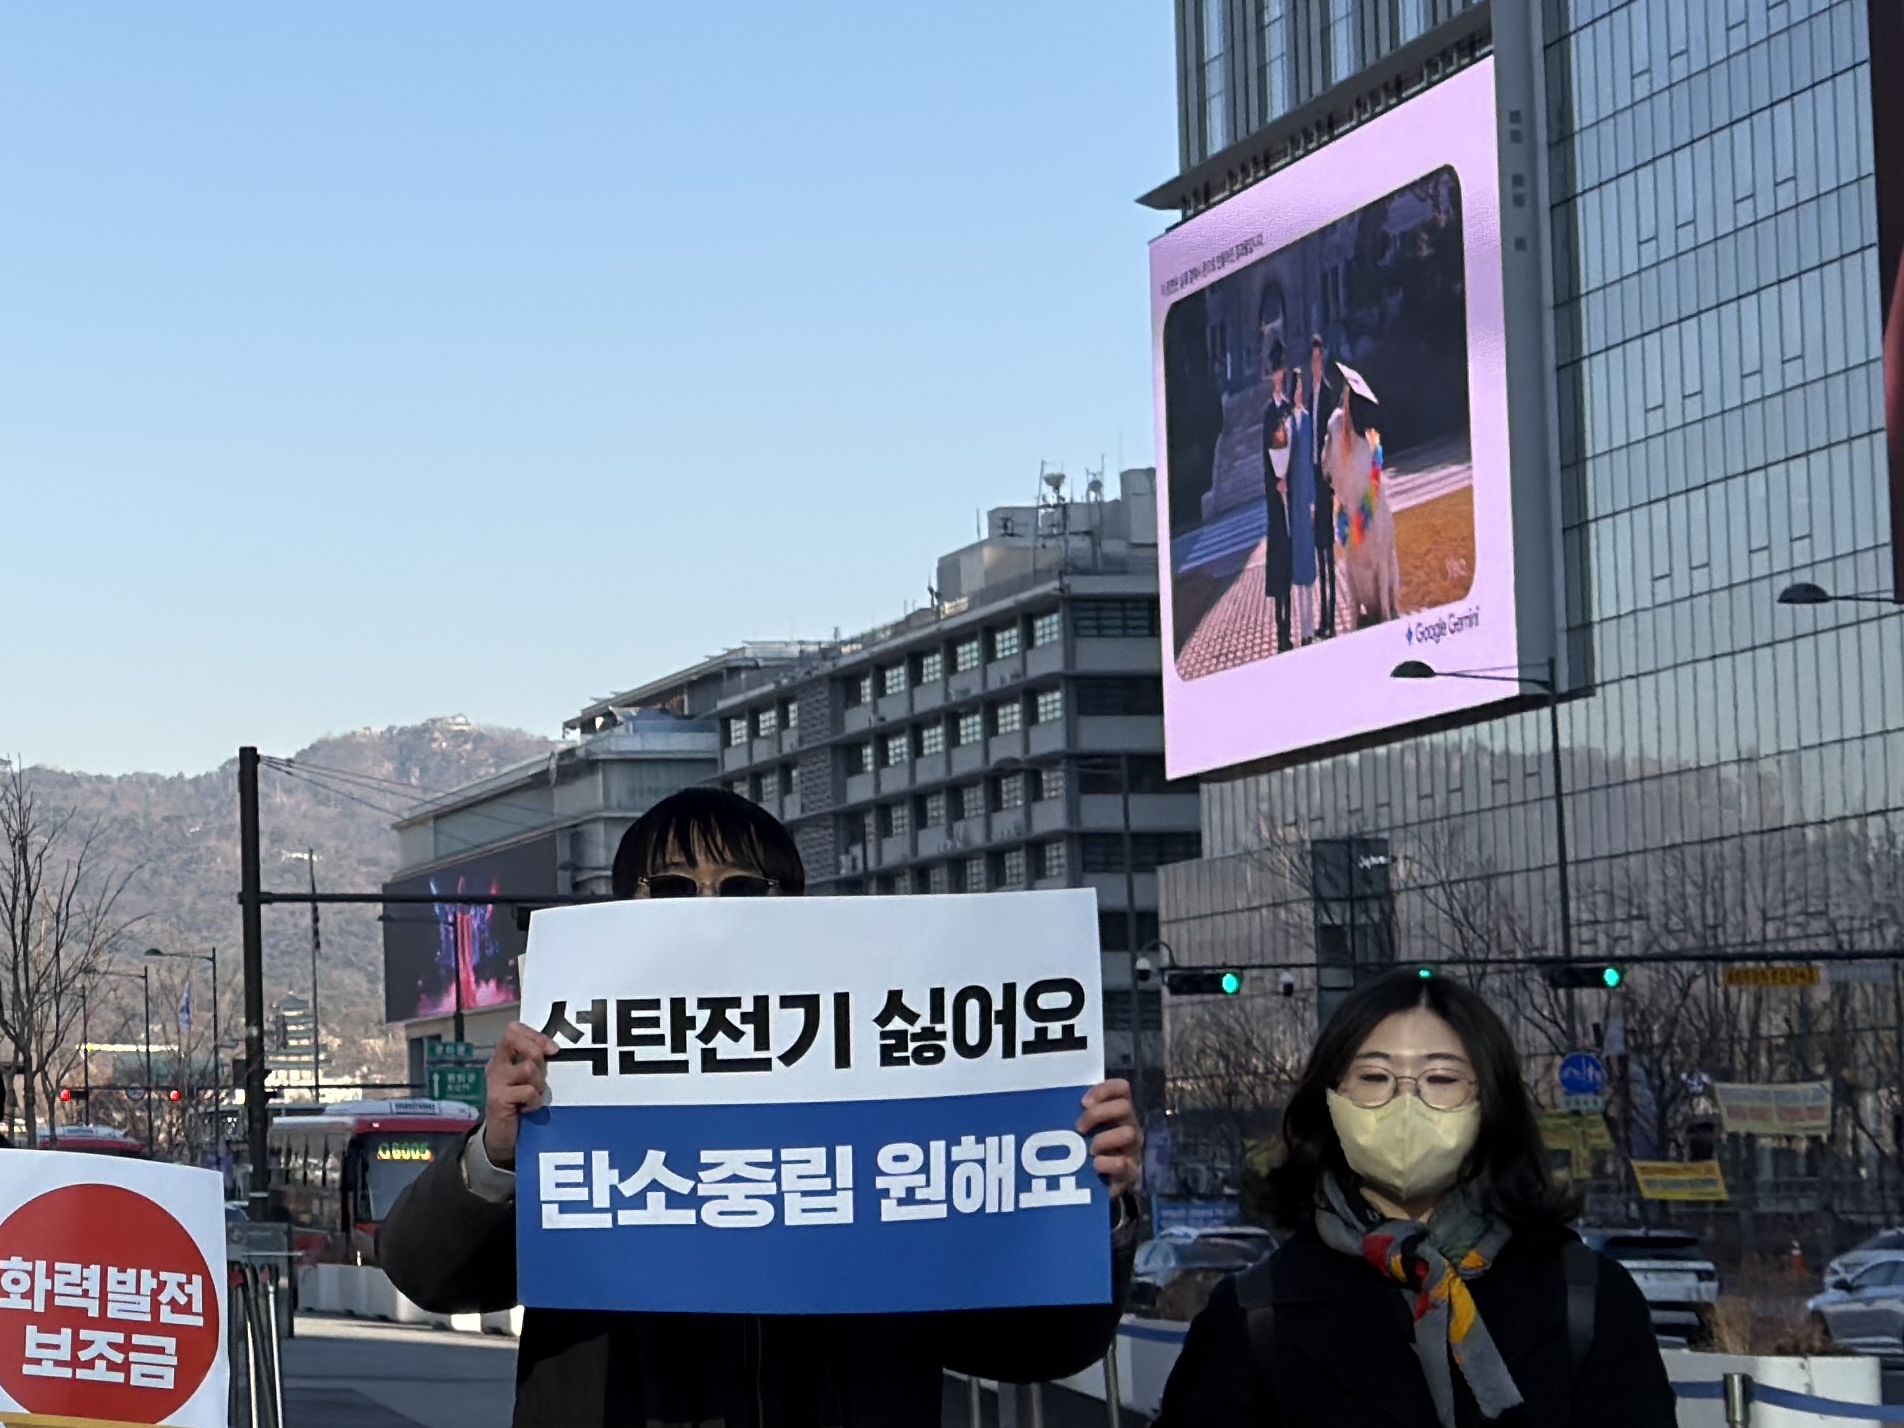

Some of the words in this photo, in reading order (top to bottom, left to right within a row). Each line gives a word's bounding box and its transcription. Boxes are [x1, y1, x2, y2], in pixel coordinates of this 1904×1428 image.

[1415, 618, 1447, 645] Google
[1448, 607, 1480, 635] Gemini
[542, 991, 851, 1076] 석탄전기
[873, 977, 1088, 1067] 싫어요
[538, 1144, 854, 1229] 탄소중립
[875, 1129, 1092, 1222] 원해요
[21, 1324, 180, 1391] 보조금
